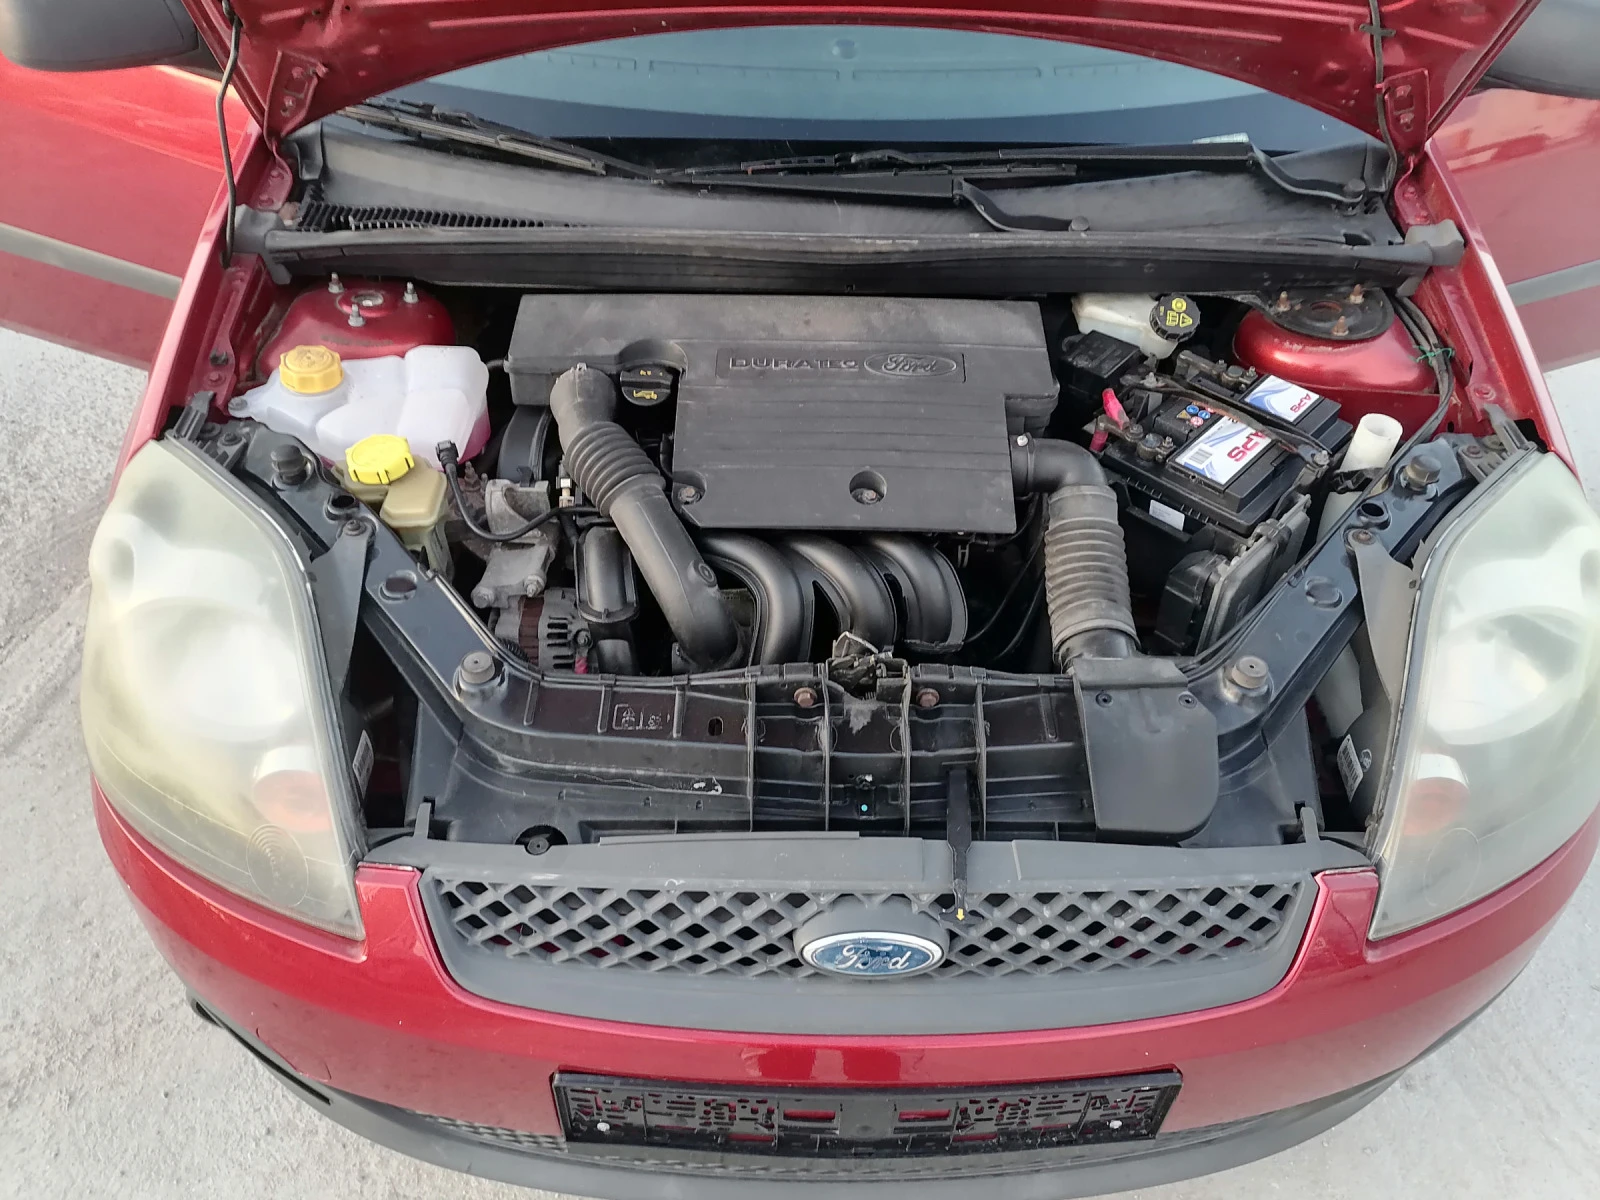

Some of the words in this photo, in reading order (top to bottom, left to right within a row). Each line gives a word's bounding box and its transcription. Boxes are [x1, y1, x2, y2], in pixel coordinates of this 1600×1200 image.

[729, 357, 859, 371] DURATEC
[881, 353, 937, 374] Ford
[1290, 393, 1312, 413] APS
[836, 944, 912, 970] Ford
